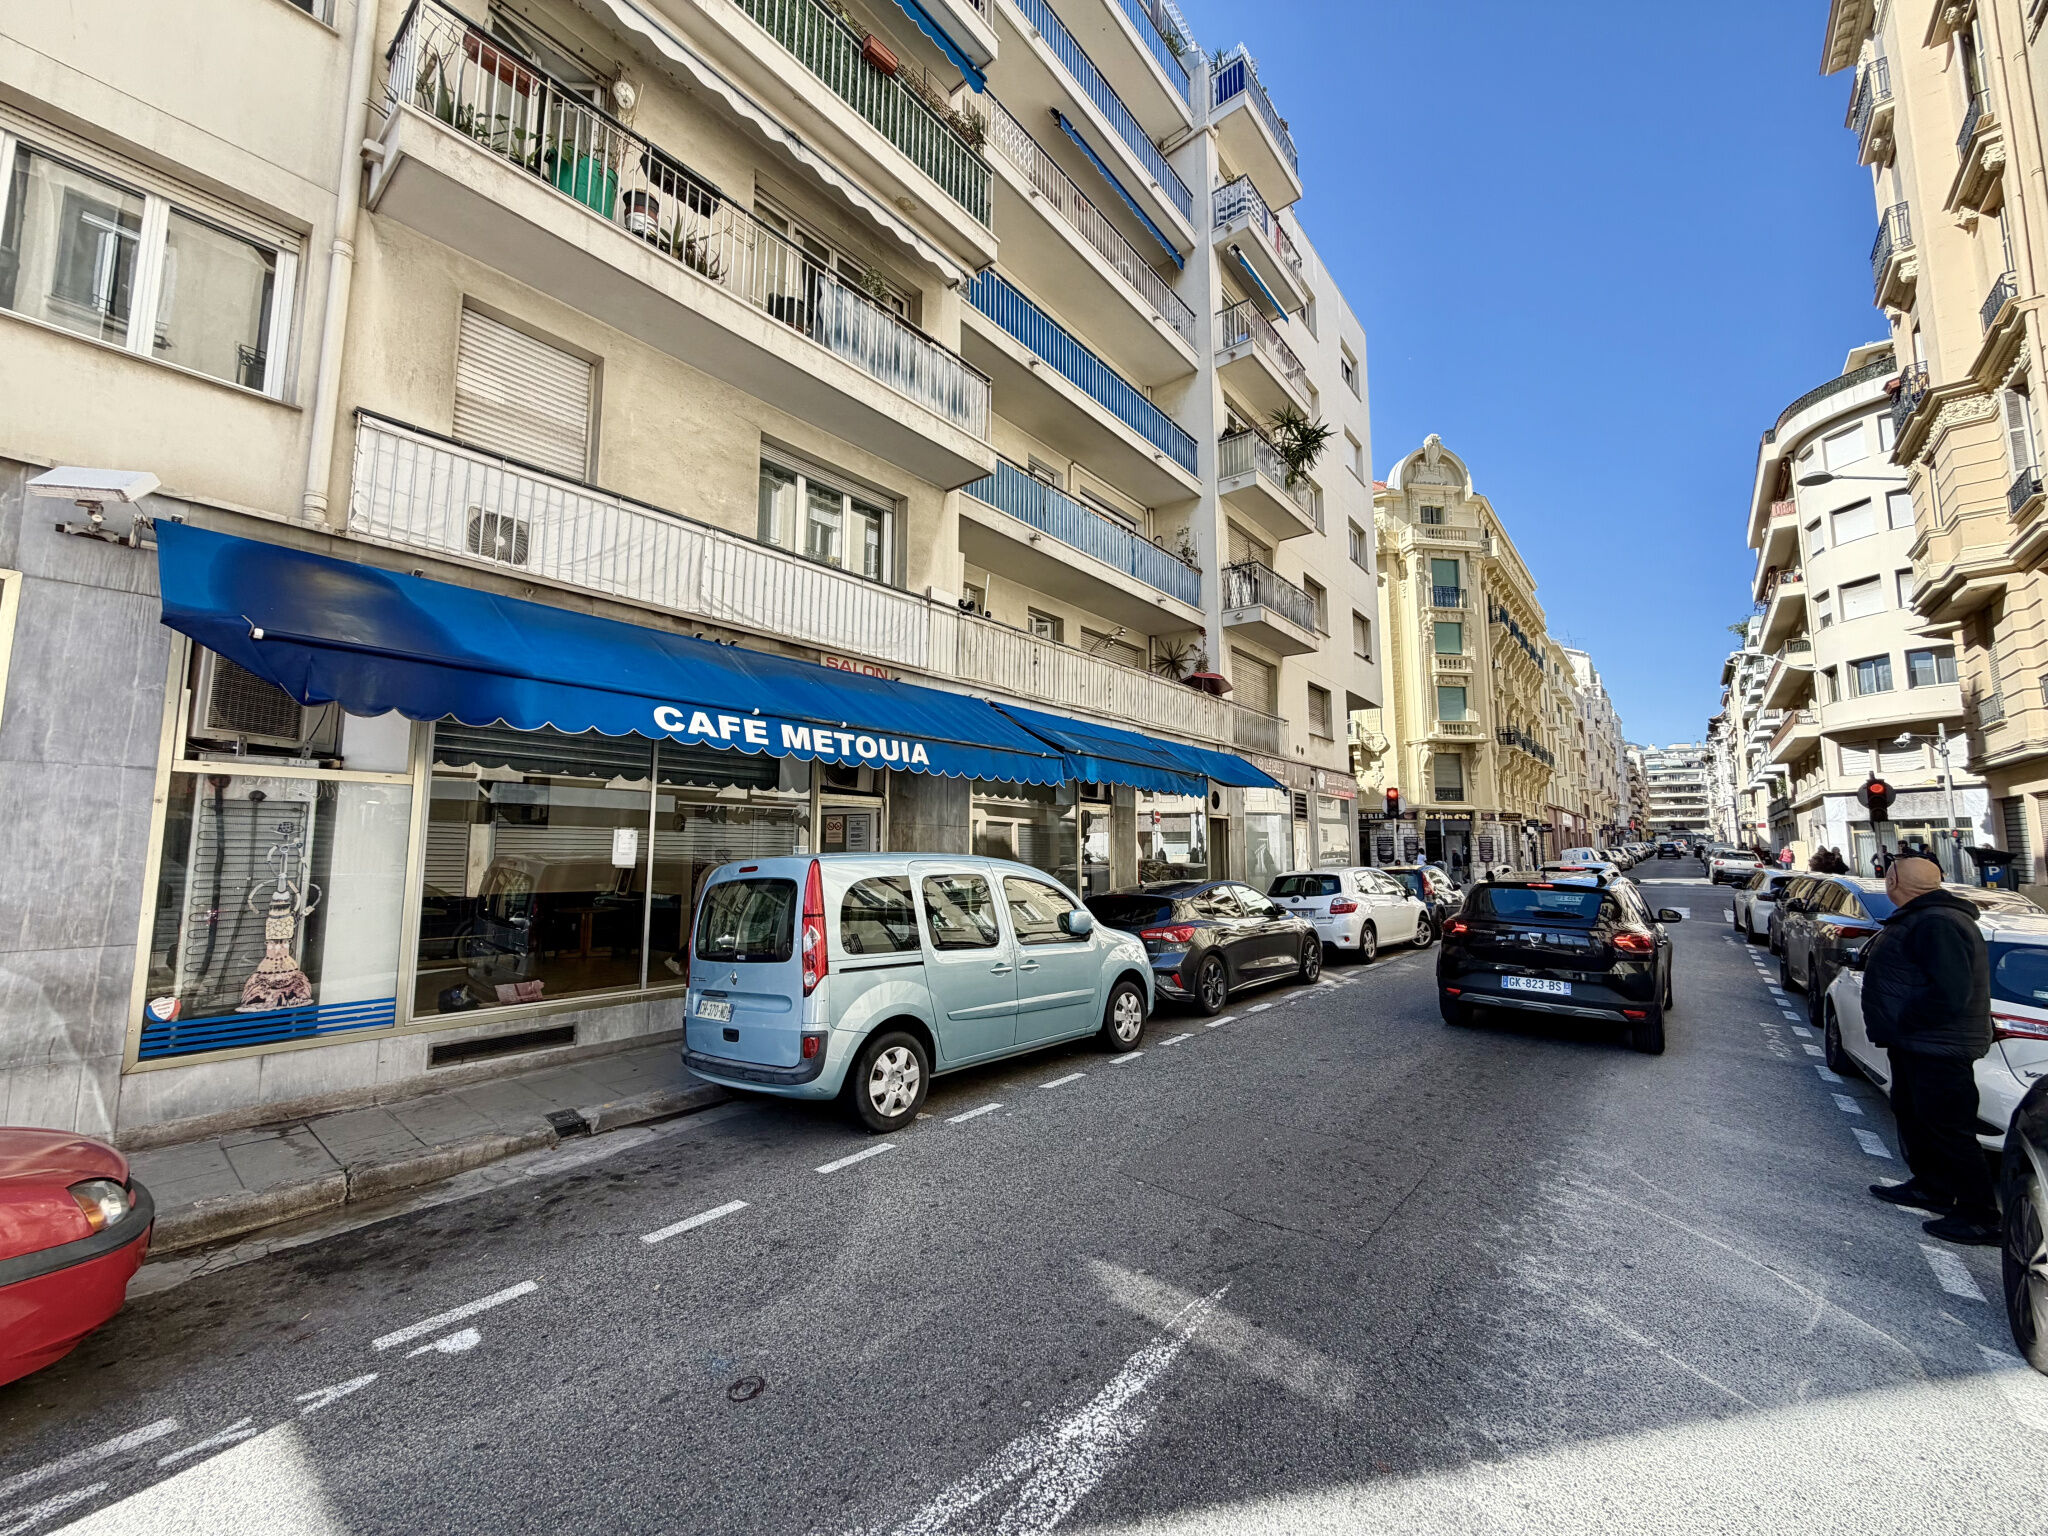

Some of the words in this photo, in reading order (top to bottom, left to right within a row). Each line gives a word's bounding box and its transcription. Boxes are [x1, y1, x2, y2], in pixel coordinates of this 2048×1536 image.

[826, 656, 888, 679] SALON
[780, 724, 930, 766] METOUIA
[1987, 865, 2001, 876] P
[1509, 977, 1562, 991] GK-823-BS
